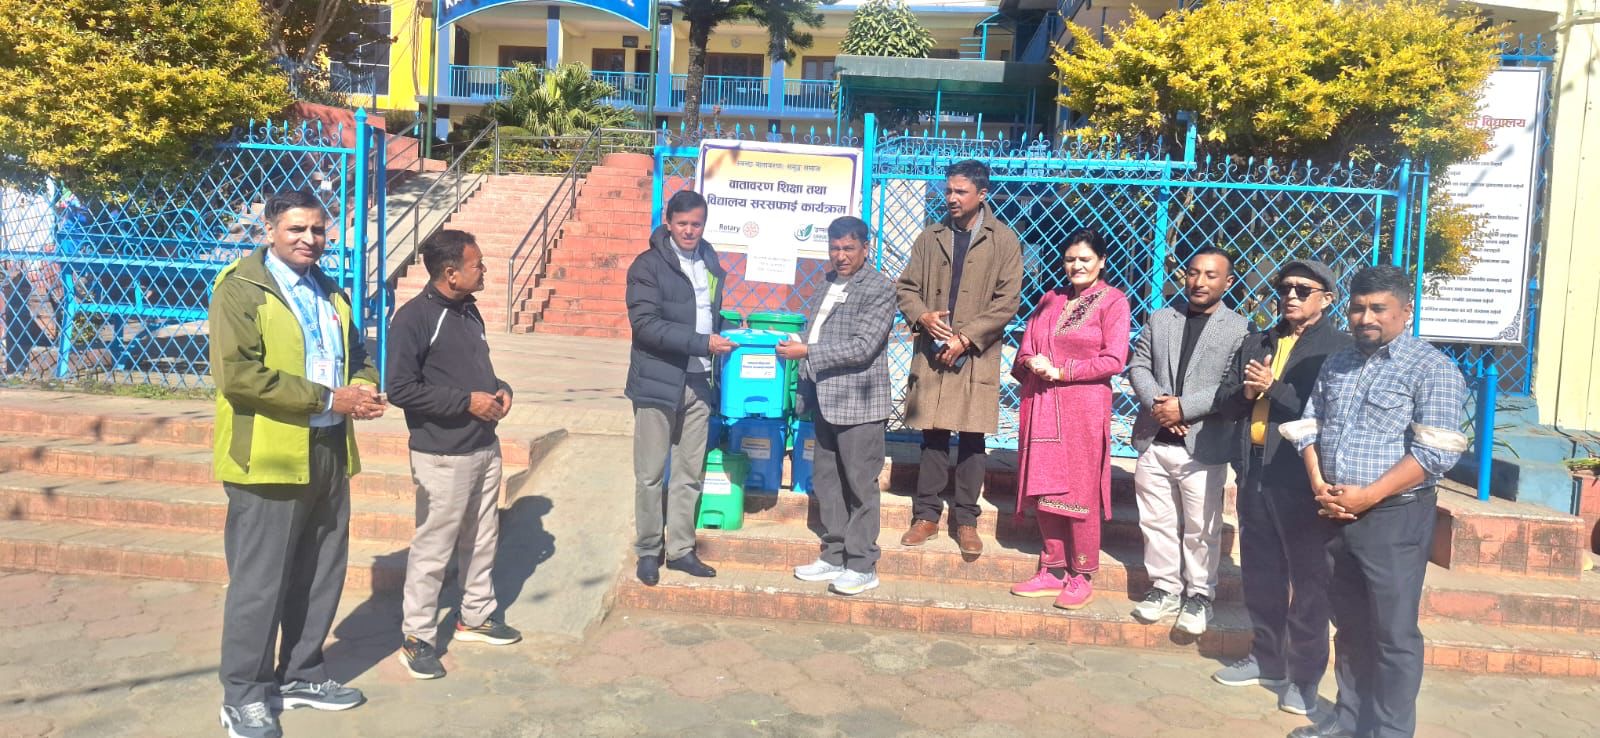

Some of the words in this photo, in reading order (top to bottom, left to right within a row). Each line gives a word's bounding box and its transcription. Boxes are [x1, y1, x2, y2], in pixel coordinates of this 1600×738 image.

[1482, 115, 1526, 128] विद्यालय
[729, 179, 774, 192] वातावरण
[777, 181, 803, 194] शिक्षा
[806, 185, 827, 195] तथा
[707, 193, 747, 208] विद्यालय
[750, 199, 798, 212] सरसफाई
[801, 202, 847, 214] कार्यक्रम
[719, 223, 741, 233] Rotary
